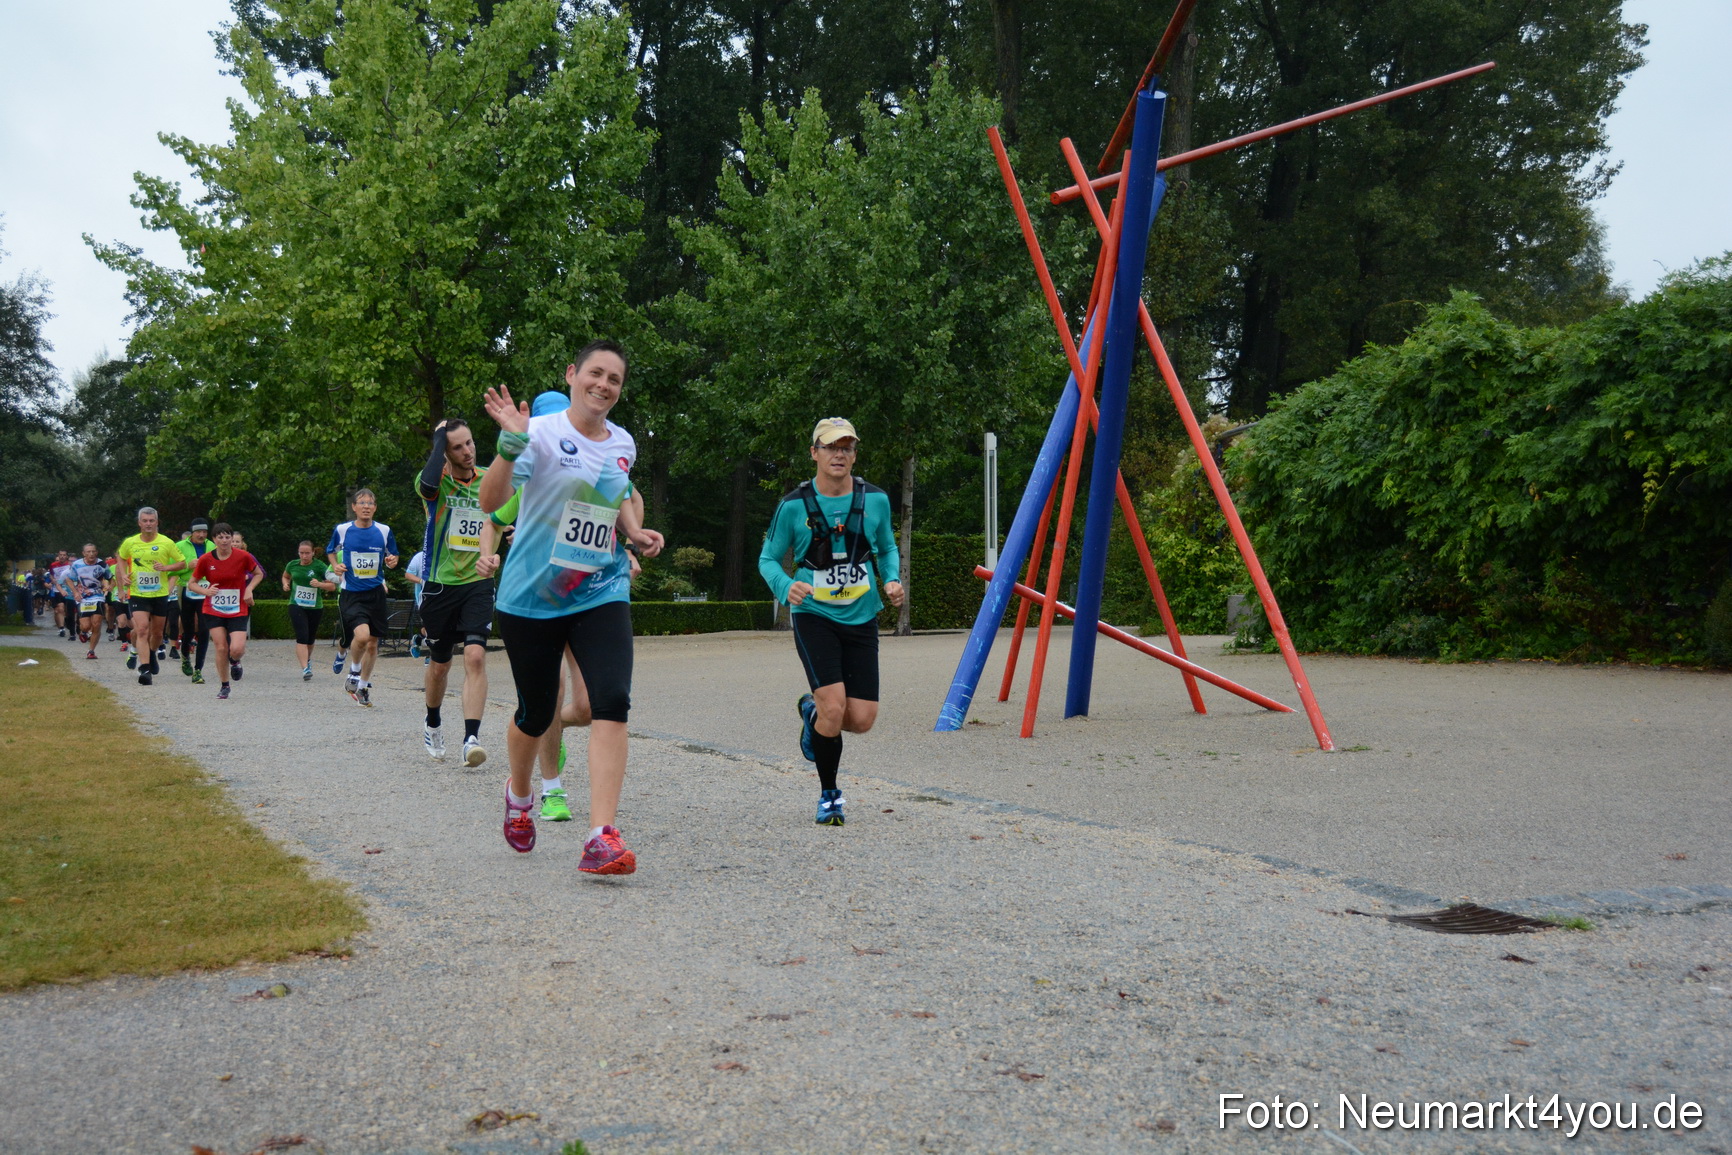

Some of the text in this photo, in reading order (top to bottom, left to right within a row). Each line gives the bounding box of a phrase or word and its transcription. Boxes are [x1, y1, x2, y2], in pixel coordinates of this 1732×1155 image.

[565, 517, 612, 549] 3003
[356, 558, 374, 569] 354
[139, 576, 160, 585] 2910
[214, 595, 238, 605] 2312
[297, 590, 315, 600] 2331
